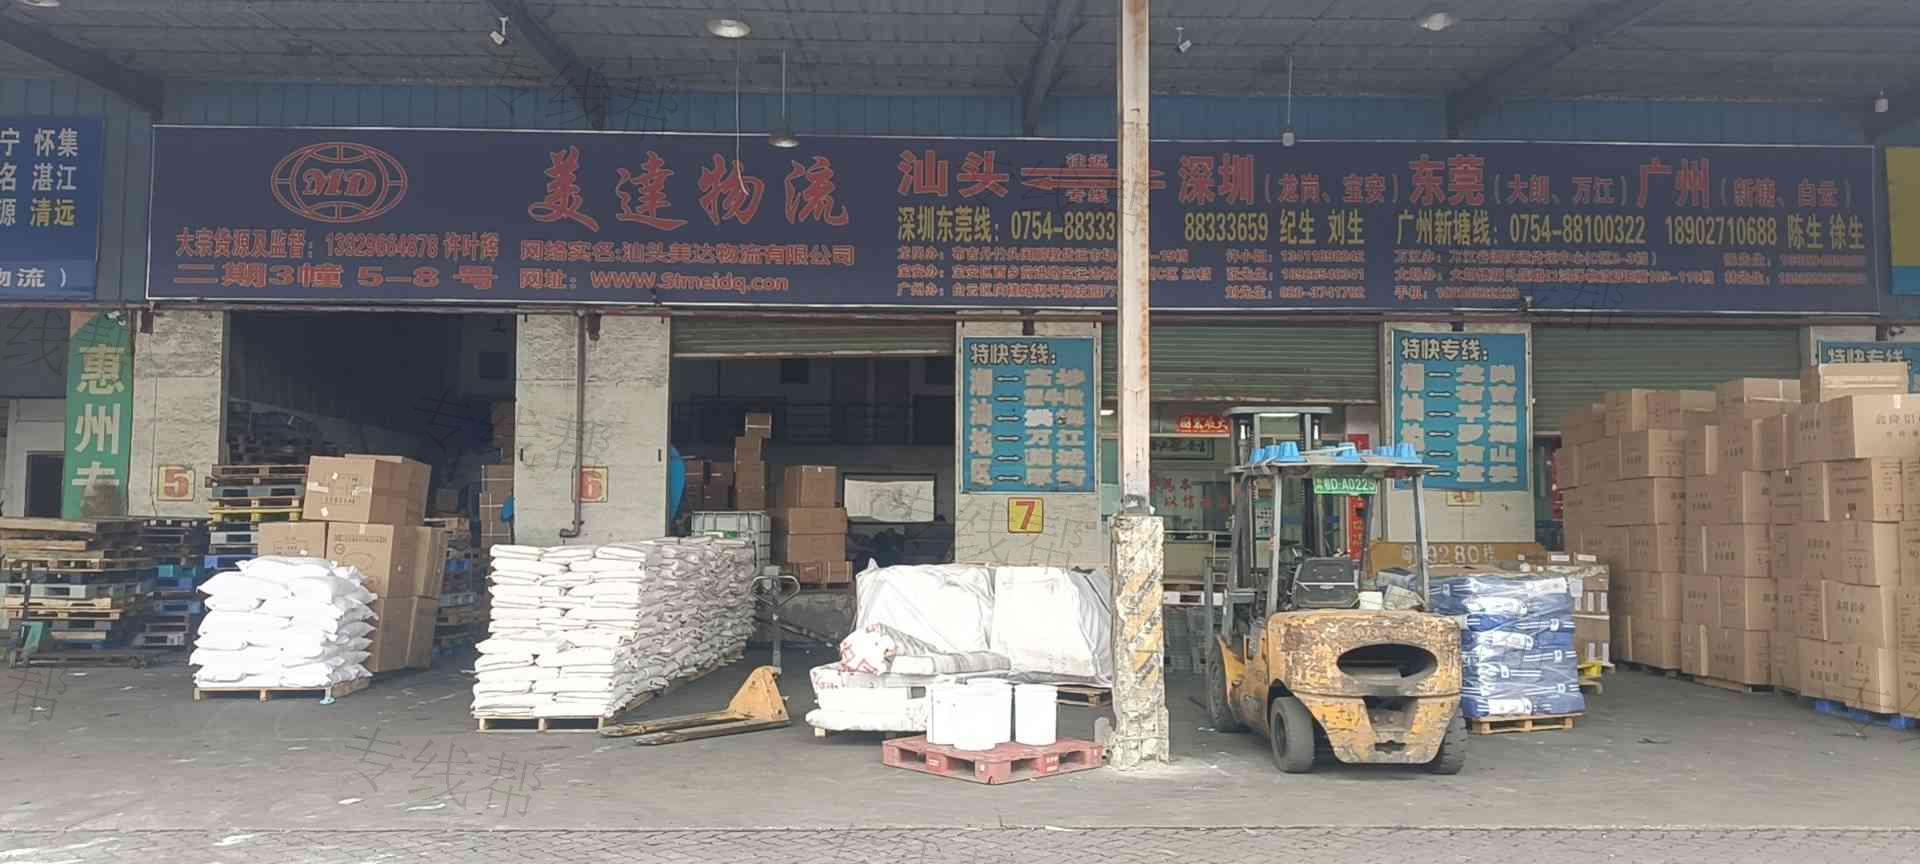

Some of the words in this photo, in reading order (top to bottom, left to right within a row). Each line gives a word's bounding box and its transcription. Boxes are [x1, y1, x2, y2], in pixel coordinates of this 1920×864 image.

[34, 128, 79, 158] 怀集
[32, 162, 77, 192] 湛江
[897, 150, 1010, 198] 汕头
[1178, 154, 1255, 206] 深圳
[1408, 154, 1487, 207] 东莞
[1637, 158, 1710, 209] 广州
[30, 198, 76, 227] 清远
[1184, 212, 1269, 243] 88333659
[1280, 209, 1317, 245] 纪生
[1328, 209, 1365, 245] 刘生
[1510, 214, 1647, 245] 0754-88100322
[1665, 215, 1778, 247] 18902710688
[1786, 213, 1824, 249] 陈生
[163, 467, 190, 498] 5
[1014, 500, 1036, 530] 7
